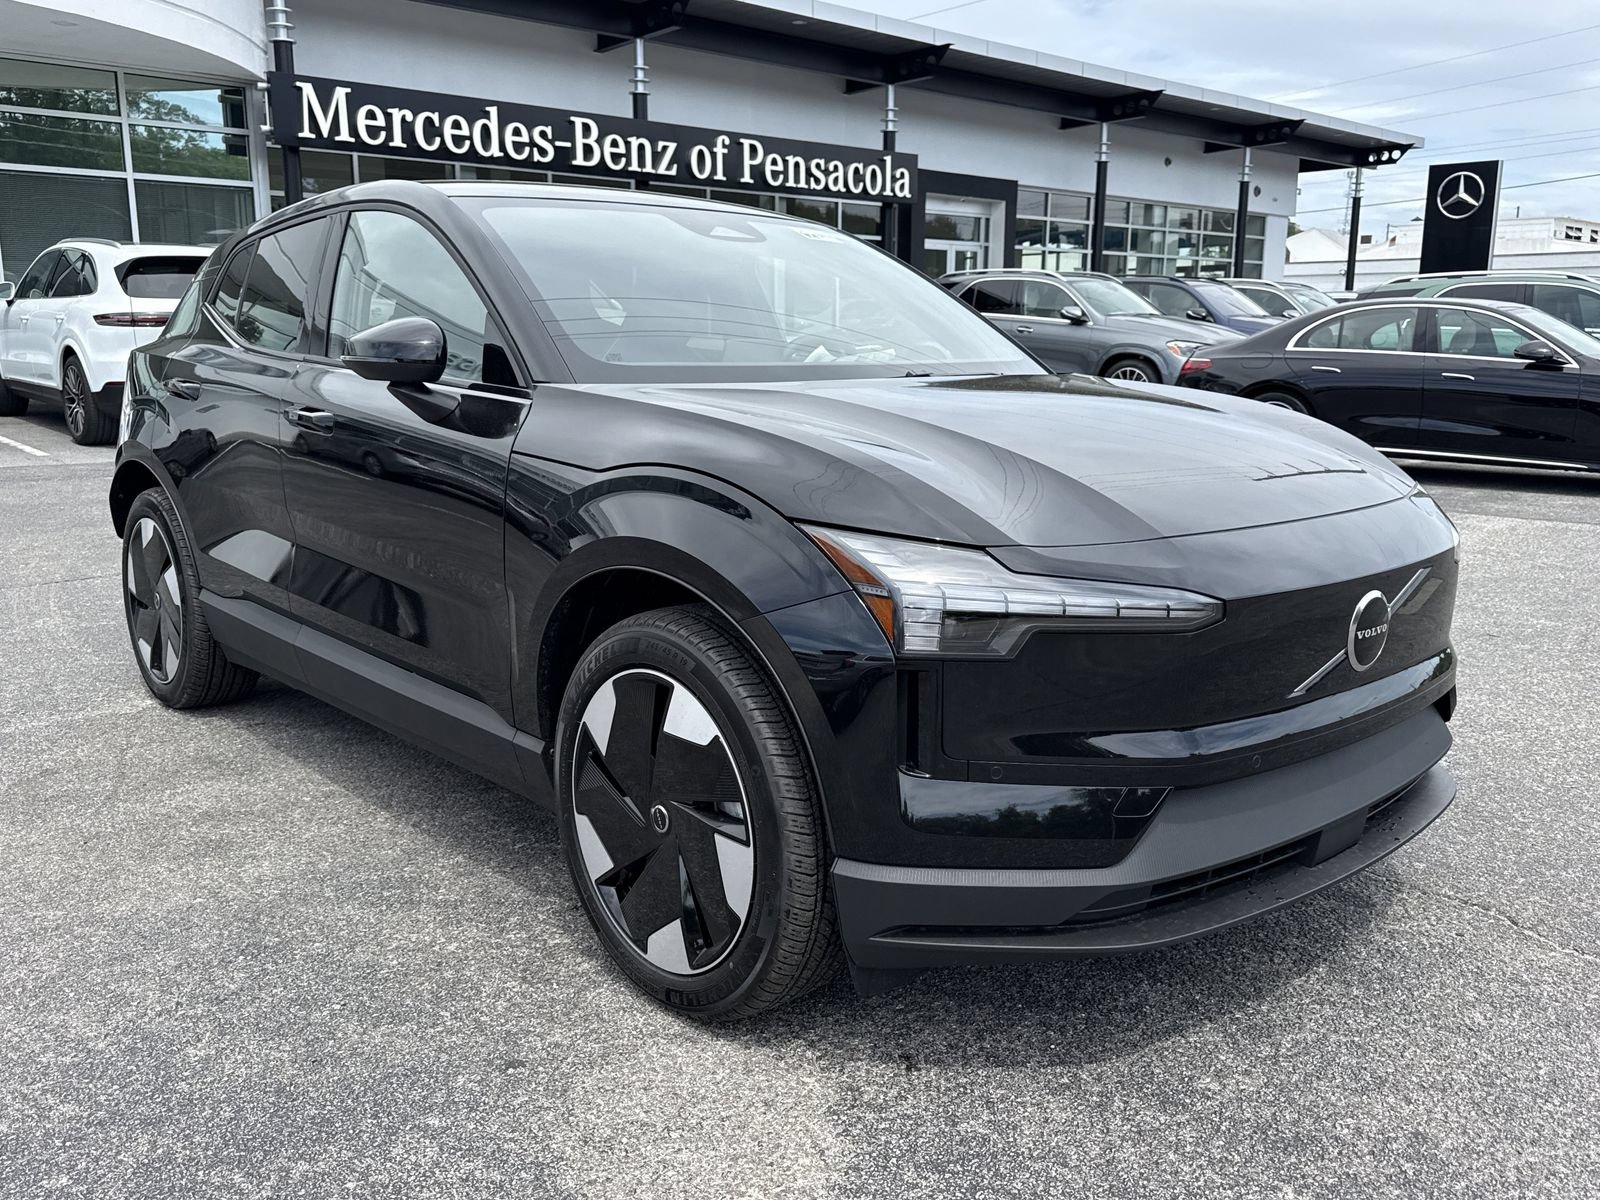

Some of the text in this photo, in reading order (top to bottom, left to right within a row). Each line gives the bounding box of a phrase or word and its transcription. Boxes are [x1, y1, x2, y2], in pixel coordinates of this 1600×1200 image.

[294, 81, 912, 198] Mercedes-Benz of Pensacola
[1356, 623, 1388, 640] VOLVO
